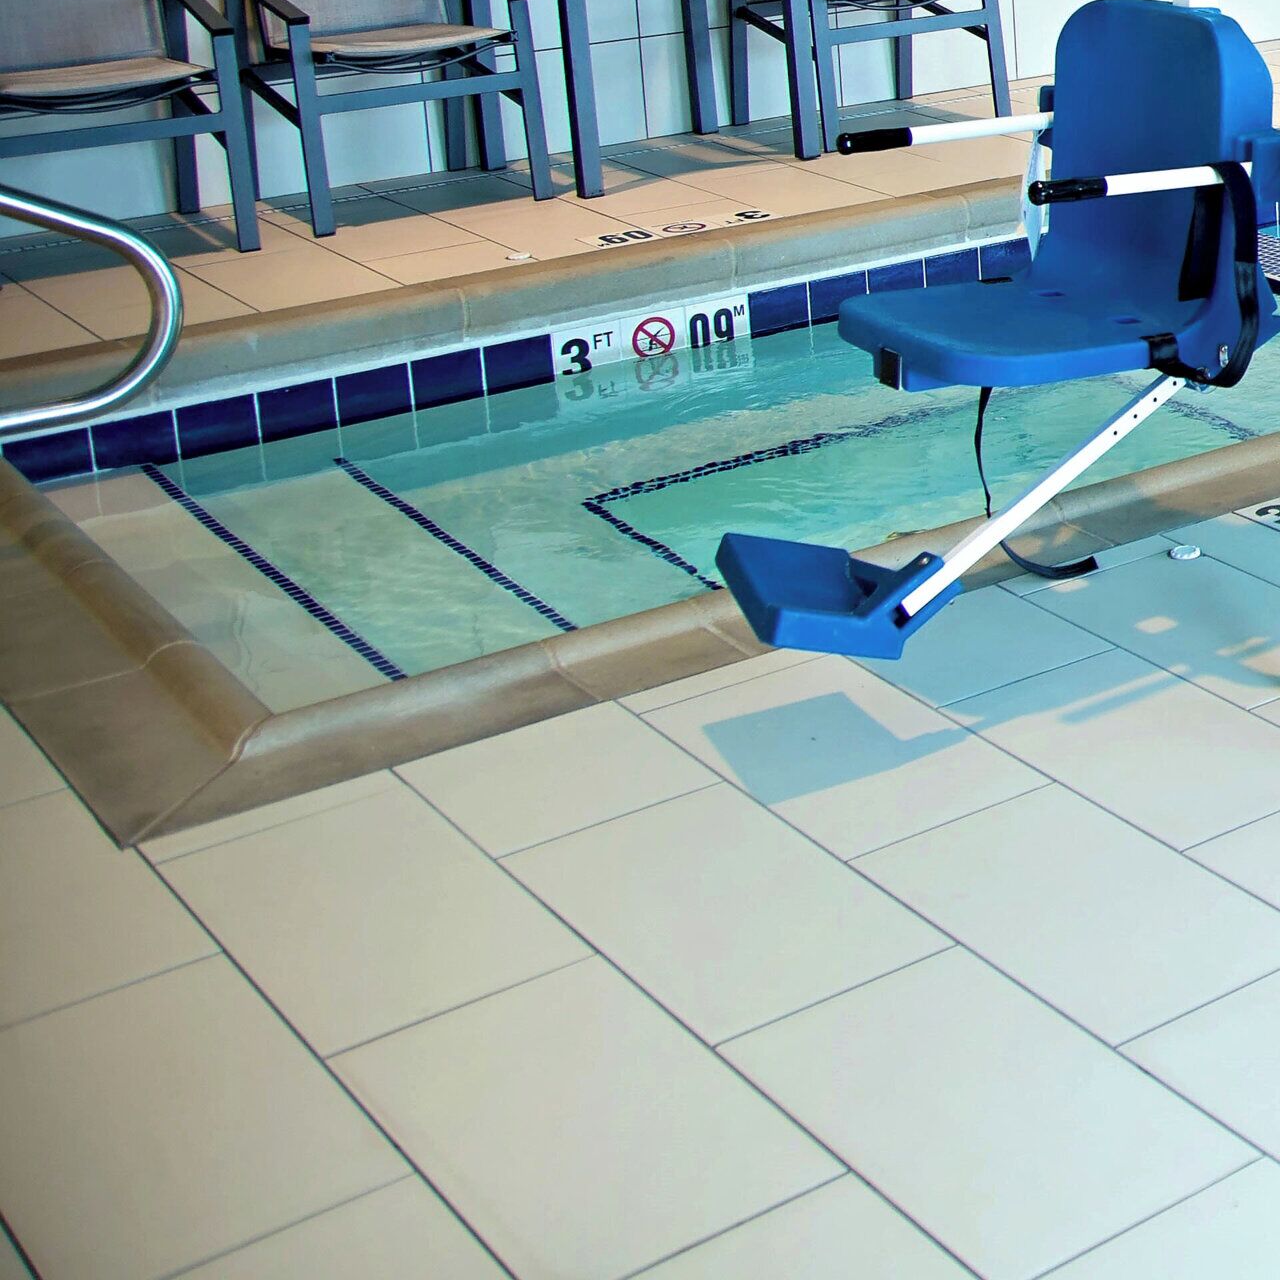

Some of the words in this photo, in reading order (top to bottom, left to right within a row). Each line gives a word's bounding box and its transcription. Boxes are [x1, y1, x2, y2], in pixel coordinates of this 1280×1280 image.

[733, 304, 745, 317] M
[561, 338, 592, 376] 3
[594, 331, 613, 350] FT
